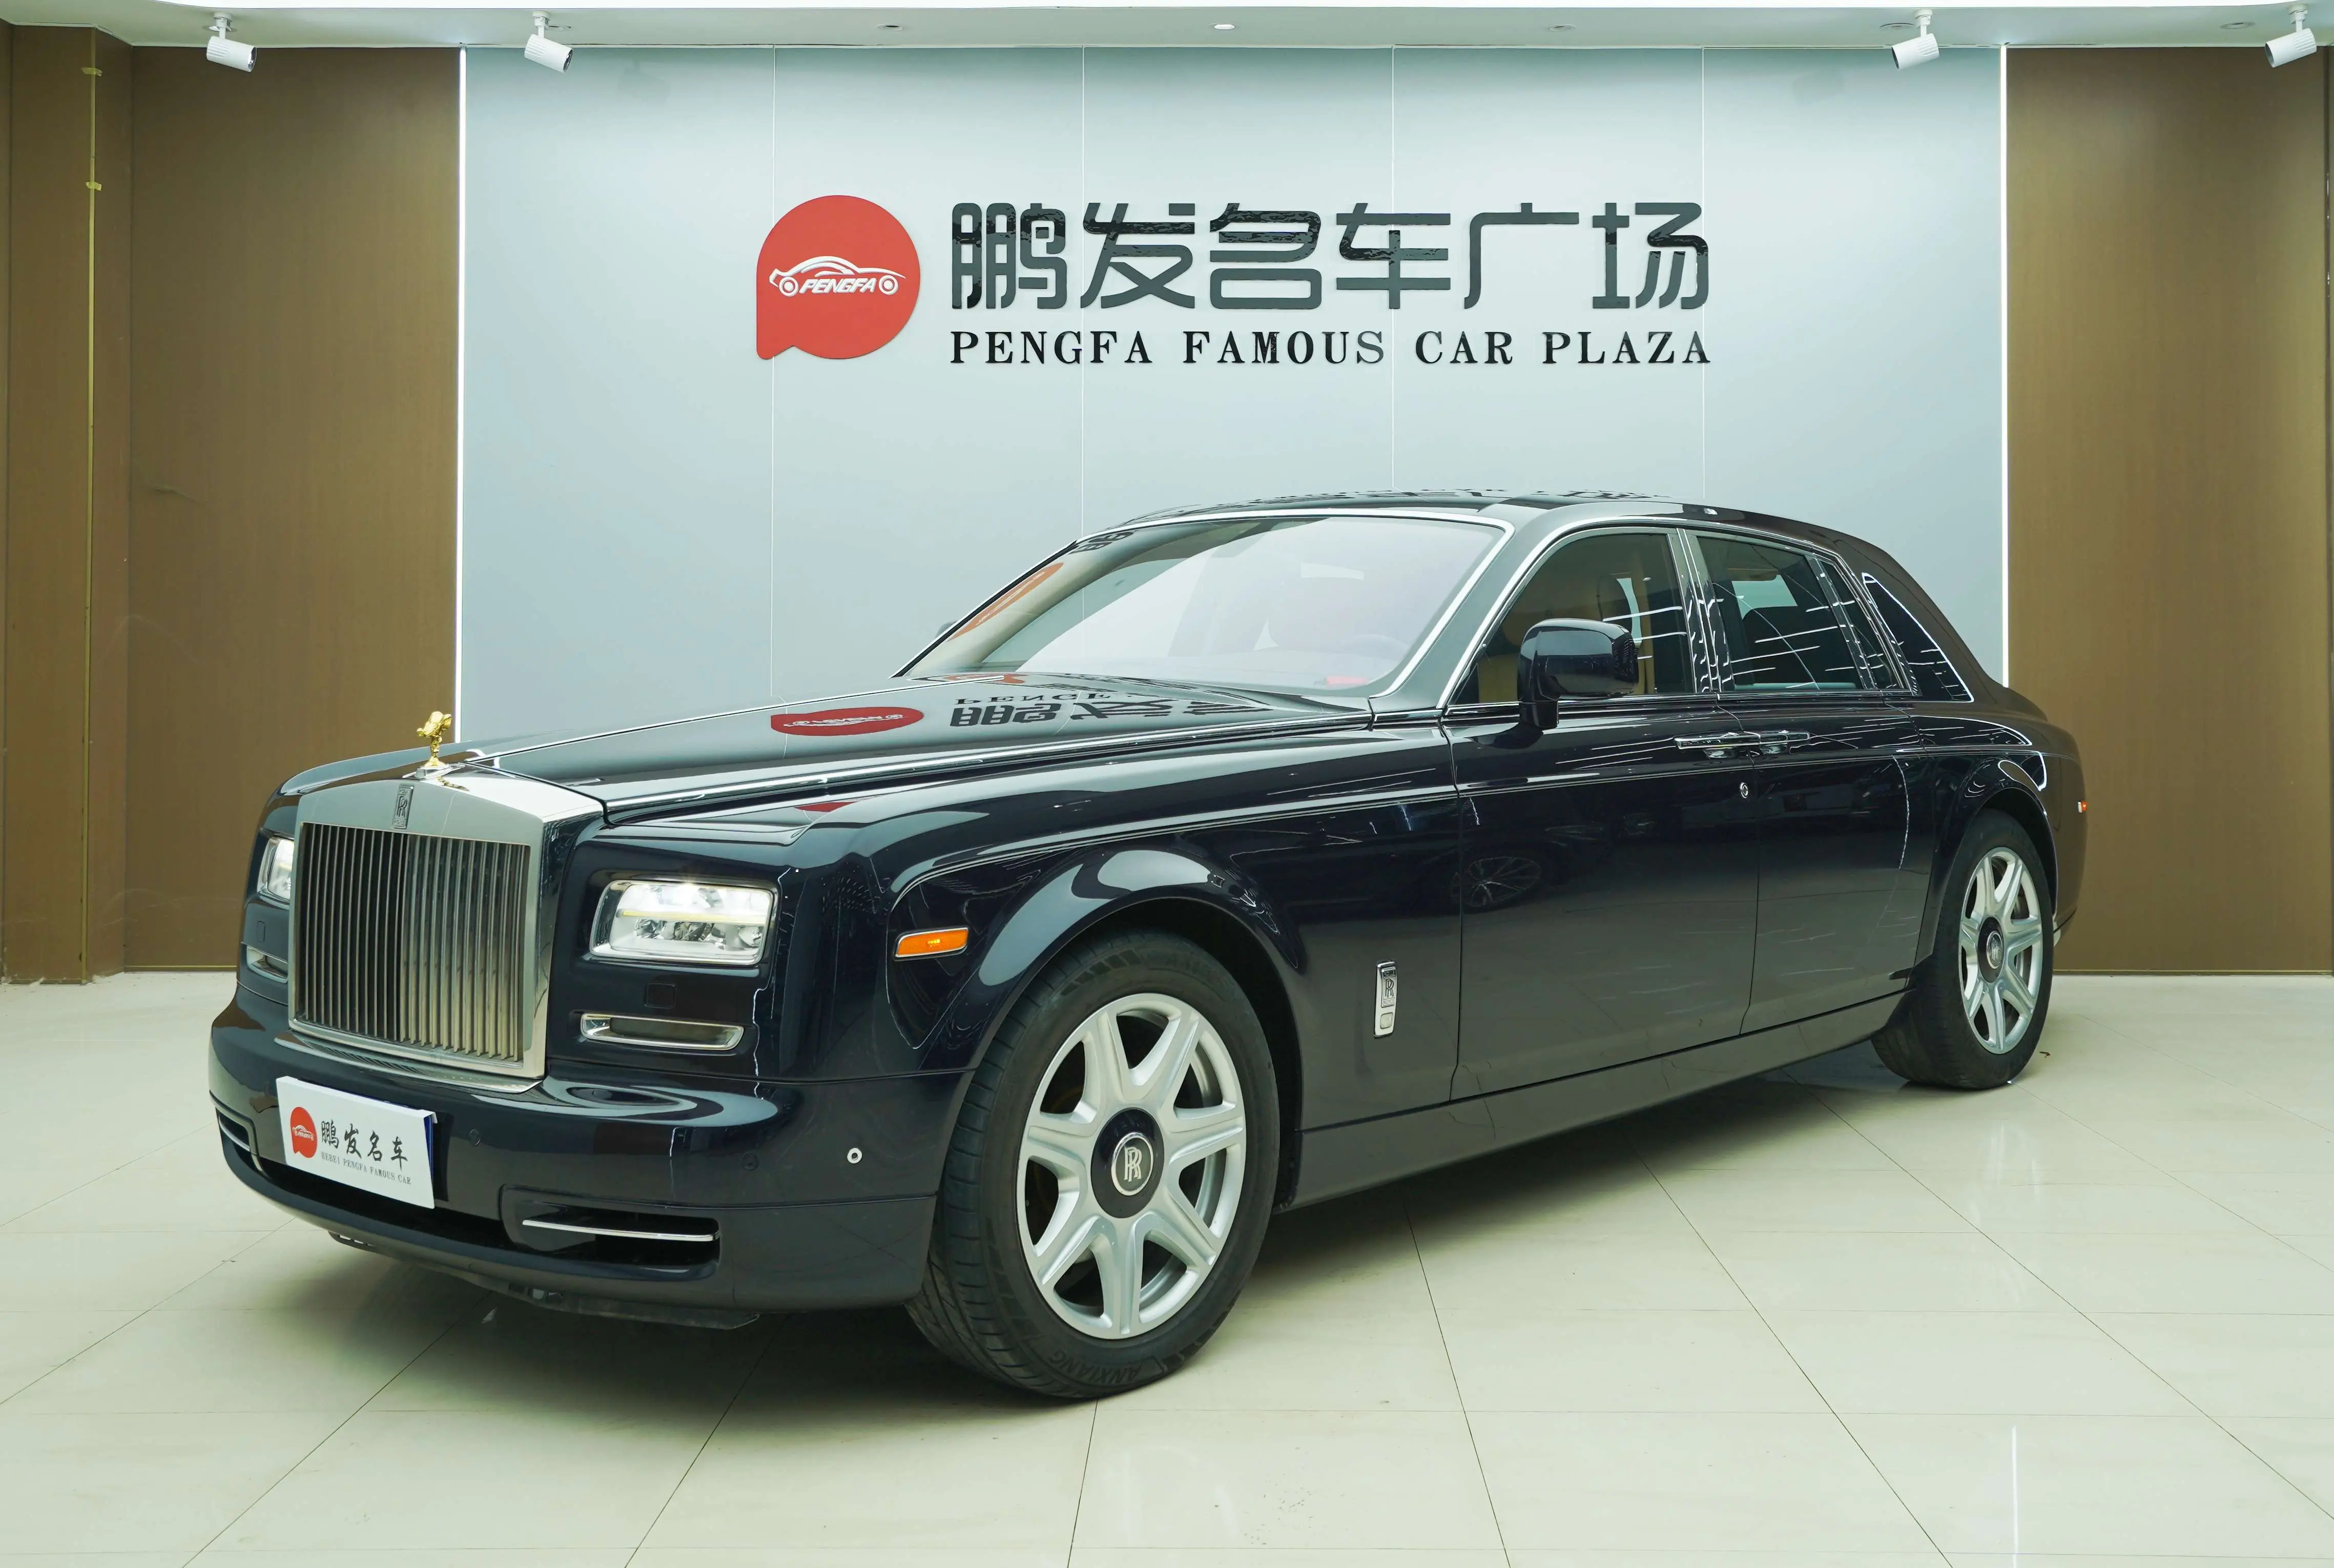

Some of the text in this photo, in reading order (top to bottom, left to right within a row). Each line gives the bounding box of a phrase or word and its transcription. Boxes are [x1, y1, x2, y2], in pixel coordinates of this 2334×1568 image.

[951, 202, 1711, 311] 鹏发名车广场
[799, 277, 877, 294] PENGFA
[951, 331, 1711, 365] PENGFA FAMOUS CAR PLAZA
[321, 1120, 408, 1171] 鹏发名车
[343, 1159, 367, 1172] PENGFA
[370, 1166, 395, 1181] FAMOUS
[398, 1174, 411, 1185] CAR
